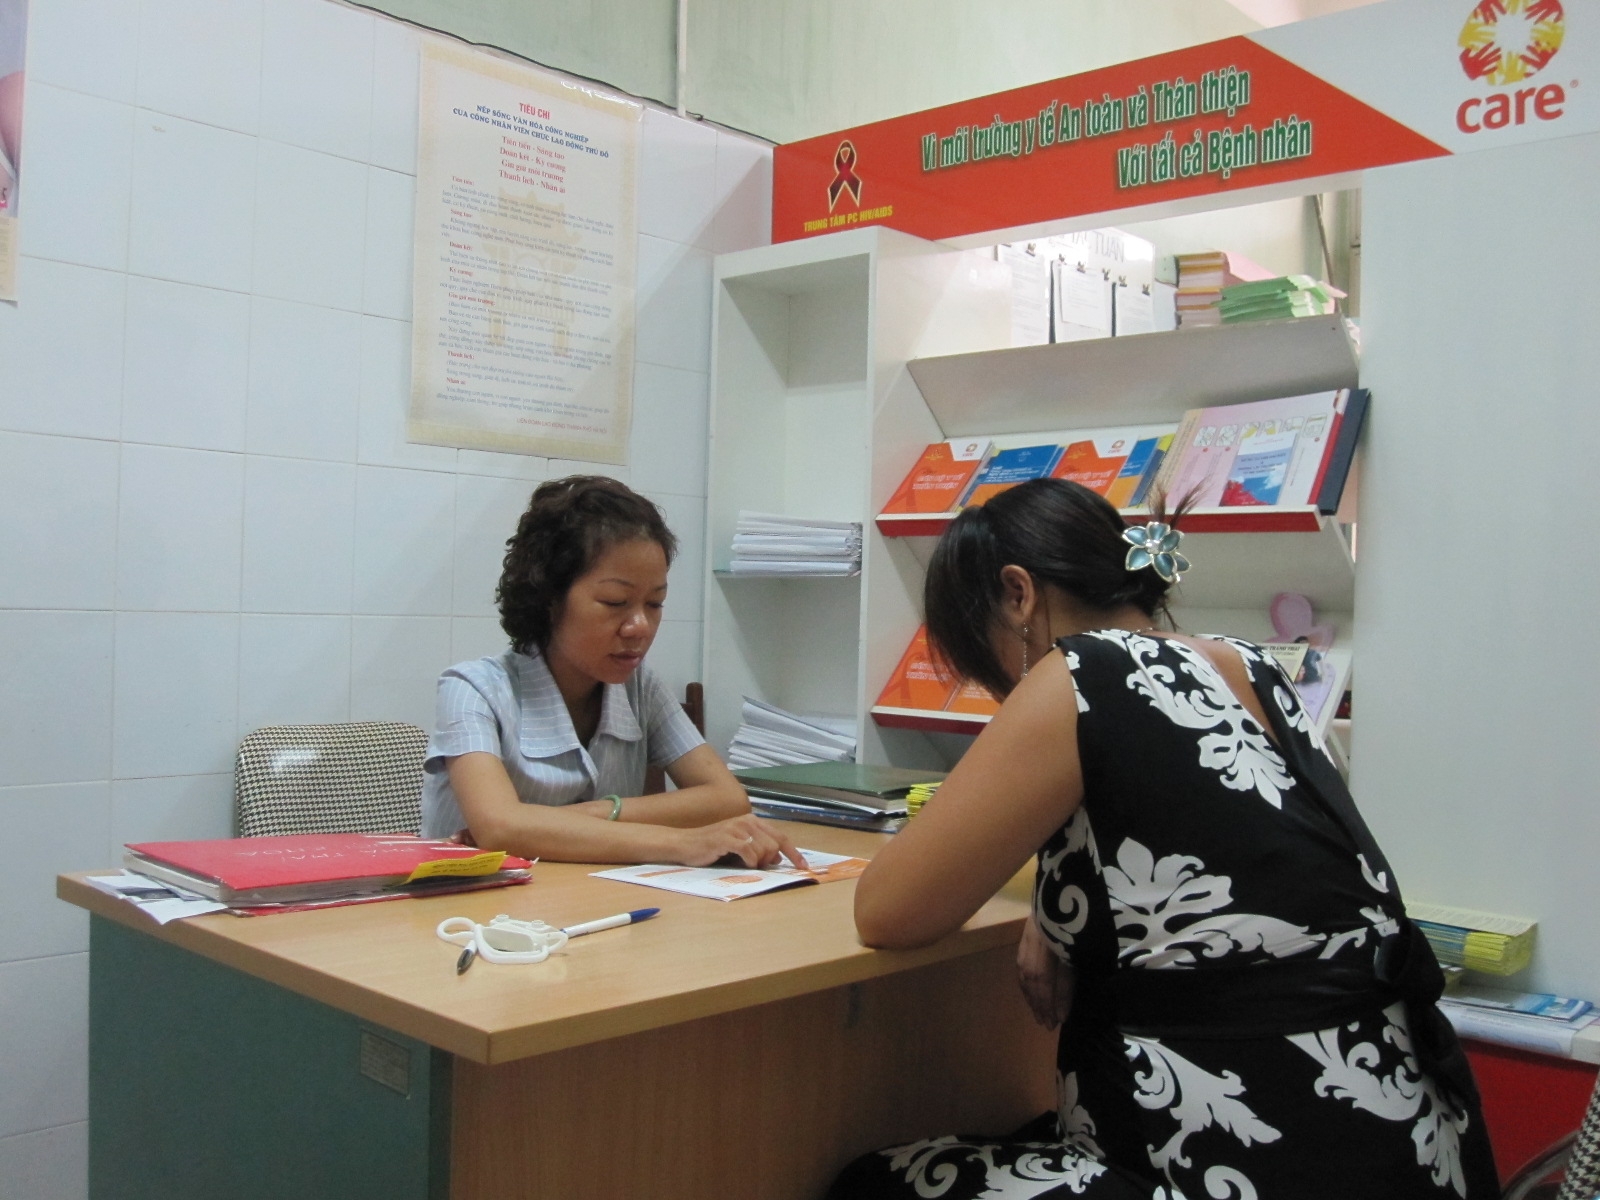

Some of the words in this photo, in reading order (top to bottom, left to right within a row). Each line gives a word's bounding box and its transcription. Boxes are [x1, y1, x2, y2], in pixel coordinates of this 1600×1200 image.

[922, 133, 937, 171] Vì
[940, 126, 968, 167] môi
[972, 114, 1022, 161] trường
[1025, 117, 1036, 154] y
[1039, 99, 1058, 147] tế
[1058, 103, 1082, 143] An
[1085, 93, 1123, 138] toàn
[1127, 85, 1149, 128] và
[1153, 77, 1197, 122] Thân
[1201, 65, 1250, 118] thiện
[1456, 83, 1565, 134] care
[1118, 143, 1147, 188] Với
[1151, 130, 1176, 182] tất
[1180, 128, 1204, 177] cả
[1208, 124, 1257, 179] Bệnh
[1262, 114, 1312, 163] nhân
[804, 218, 828, 232] TRUNG
[830, 214, 846, 227] TÂM
[847, 213, 858, 223] PC
[860, 205, 893, 221] HIV/AIDS
